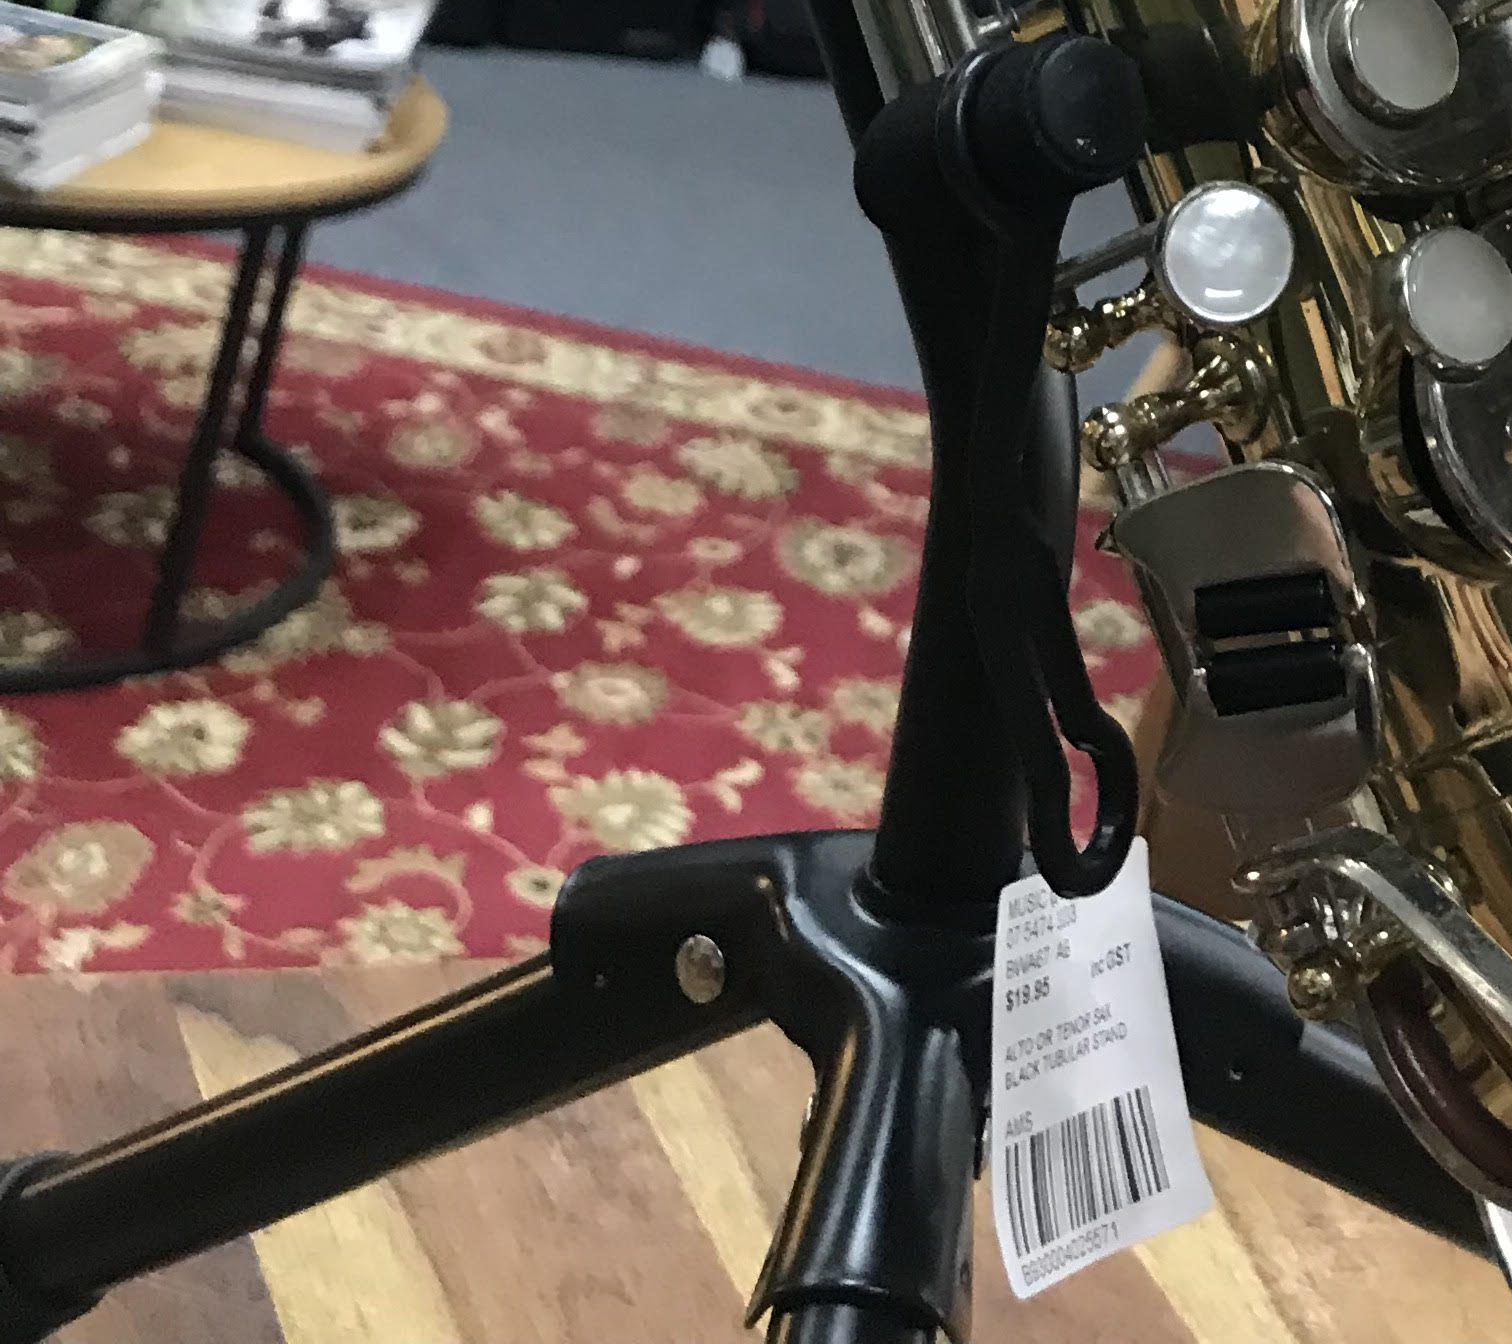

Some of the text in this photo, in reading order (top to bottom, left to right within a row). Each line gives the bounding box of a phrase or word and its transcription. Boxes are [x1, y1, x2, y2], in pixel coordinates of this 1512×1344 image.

[1105, 942, 1131, 970] GST
[1005, 976, 1050, 1012] $19.95
[1005, 1003, 1112, 1063] ALTO OR TENOR SAX
[1005, 1022, 1128, 1090] BLACK TUBULAR STAND
